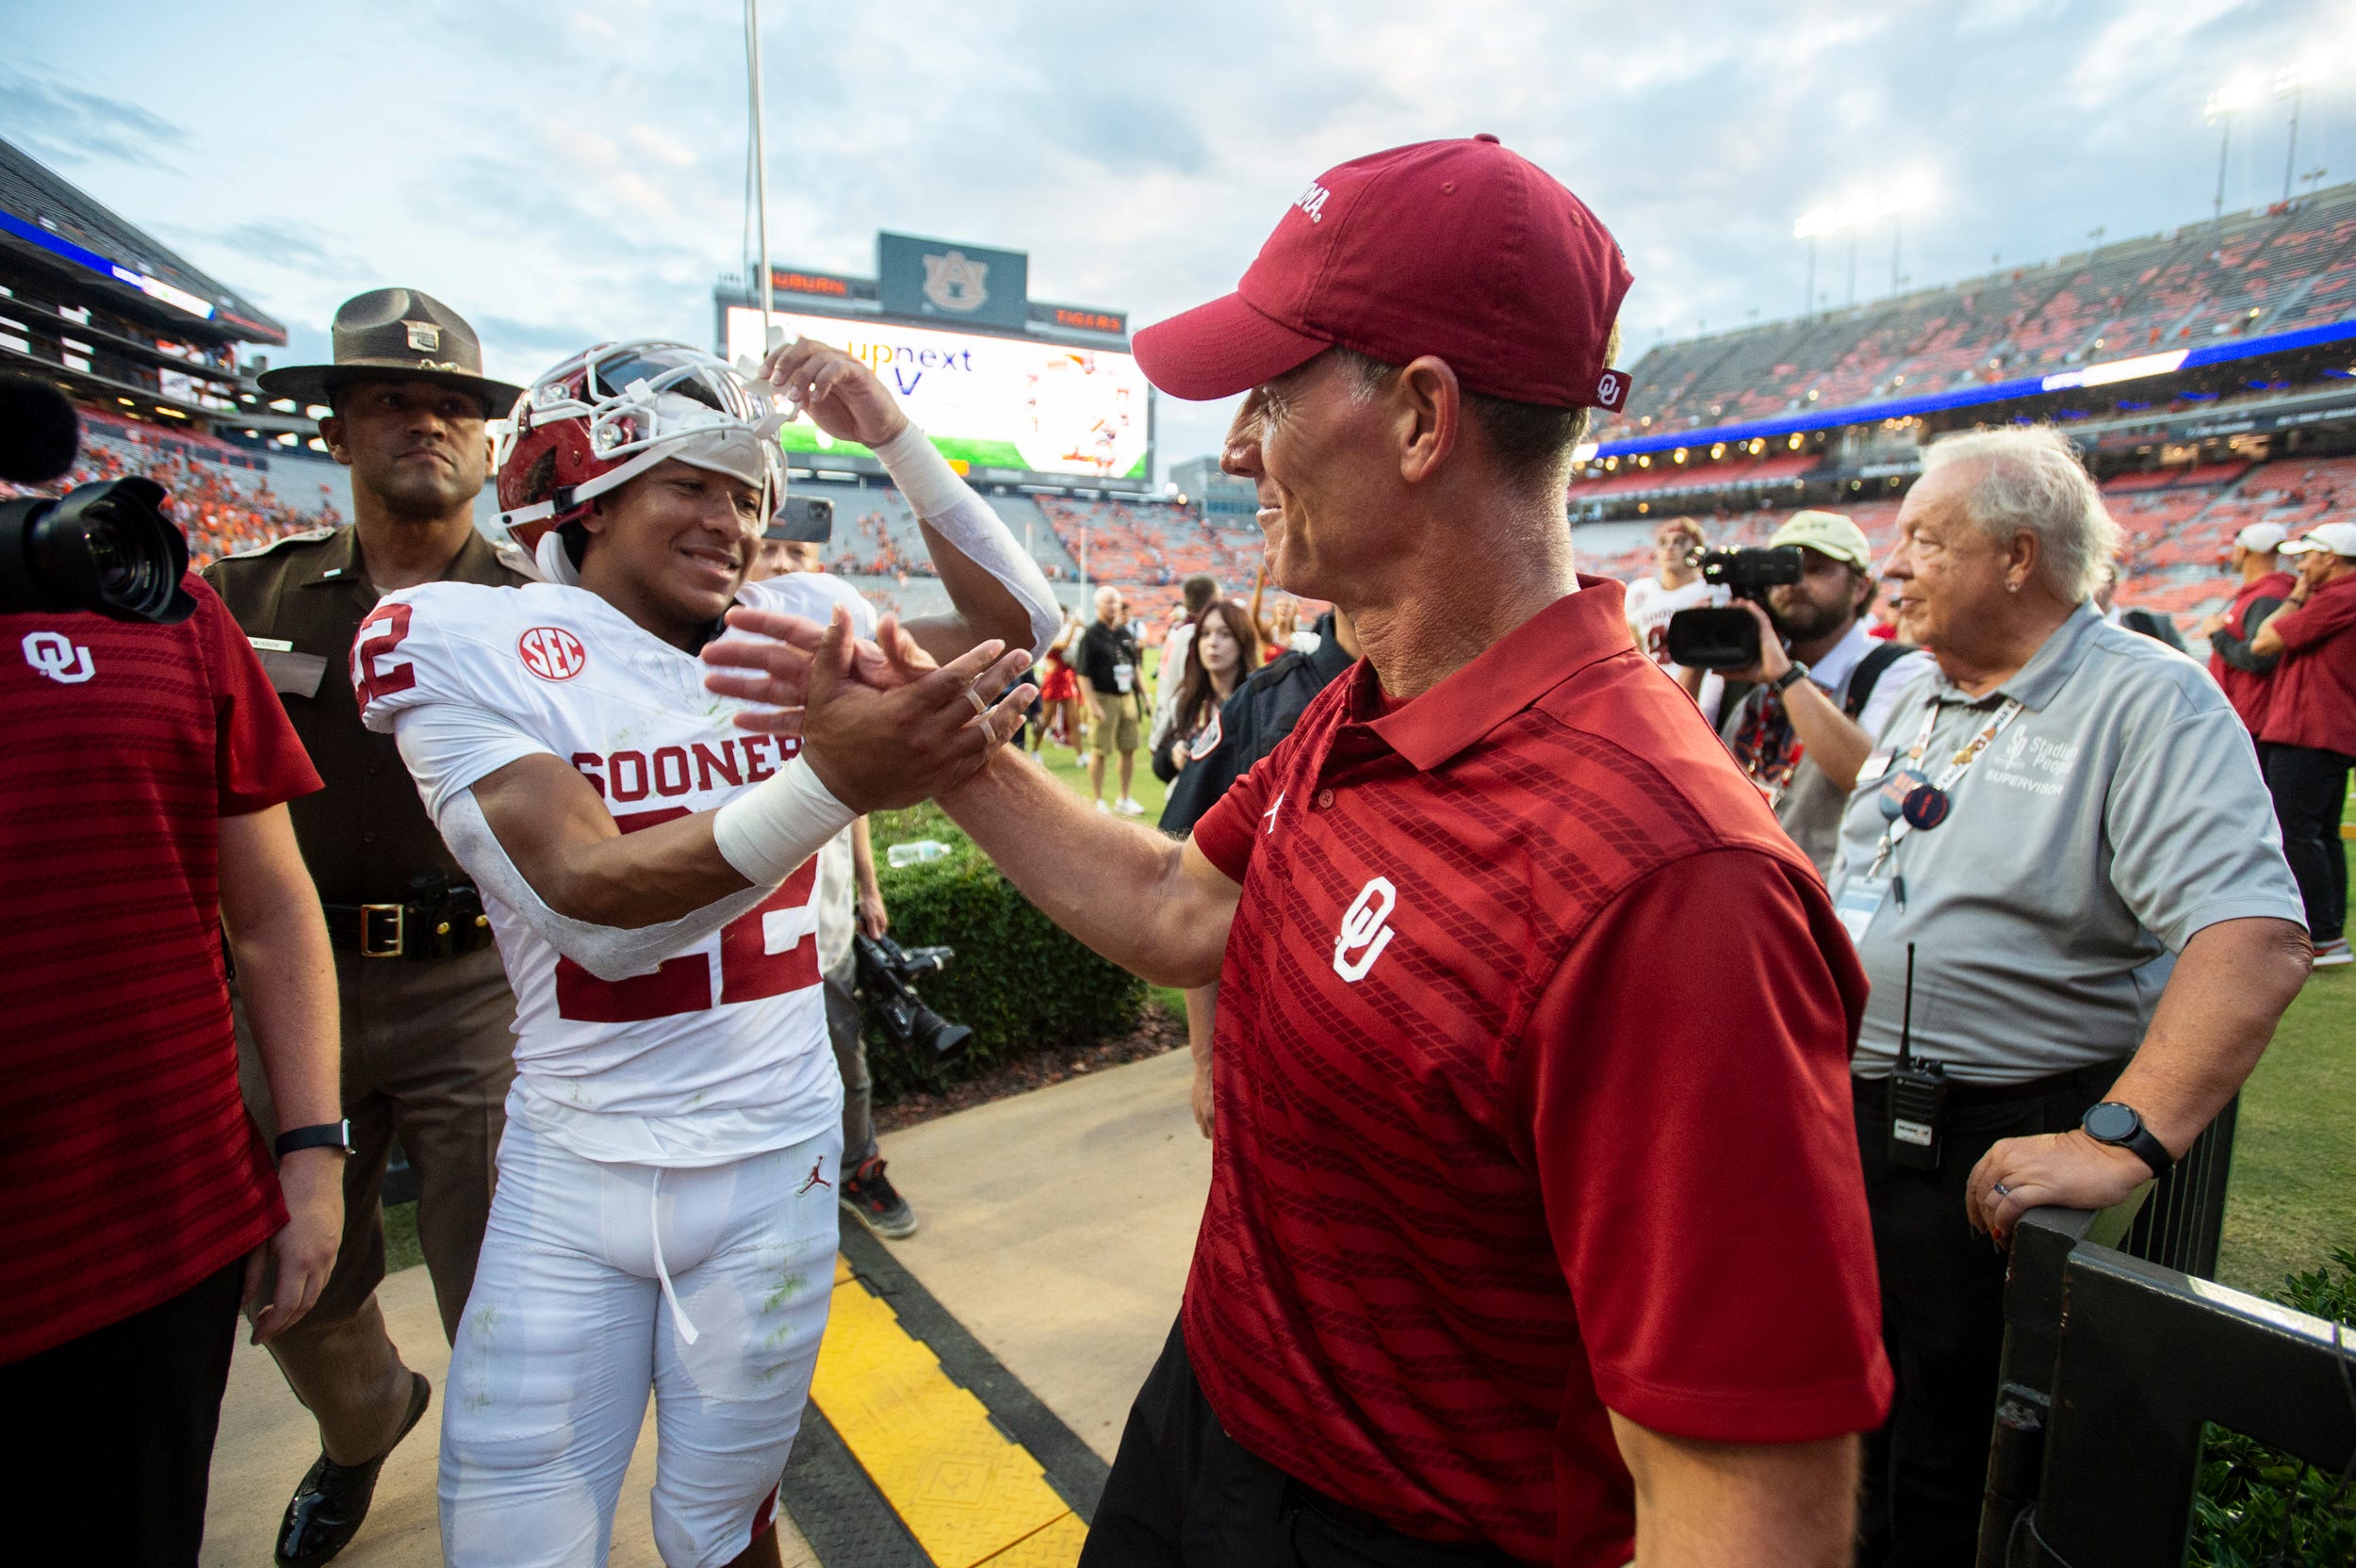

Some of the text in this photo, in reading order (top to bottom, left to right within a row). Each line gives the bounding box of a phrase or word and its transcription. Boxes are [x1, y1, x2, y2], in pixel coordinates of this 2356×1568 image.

[769, 271, 846, 297] UBURN
[1055, 308, 1121, 333] TIGERS
[848, 340, 973, 374] upnext
[349, 602, 417, 718] 2
[521, 629, 584, 679] SEC
[1985, 768, 2063, 796] SUPERVISOR
